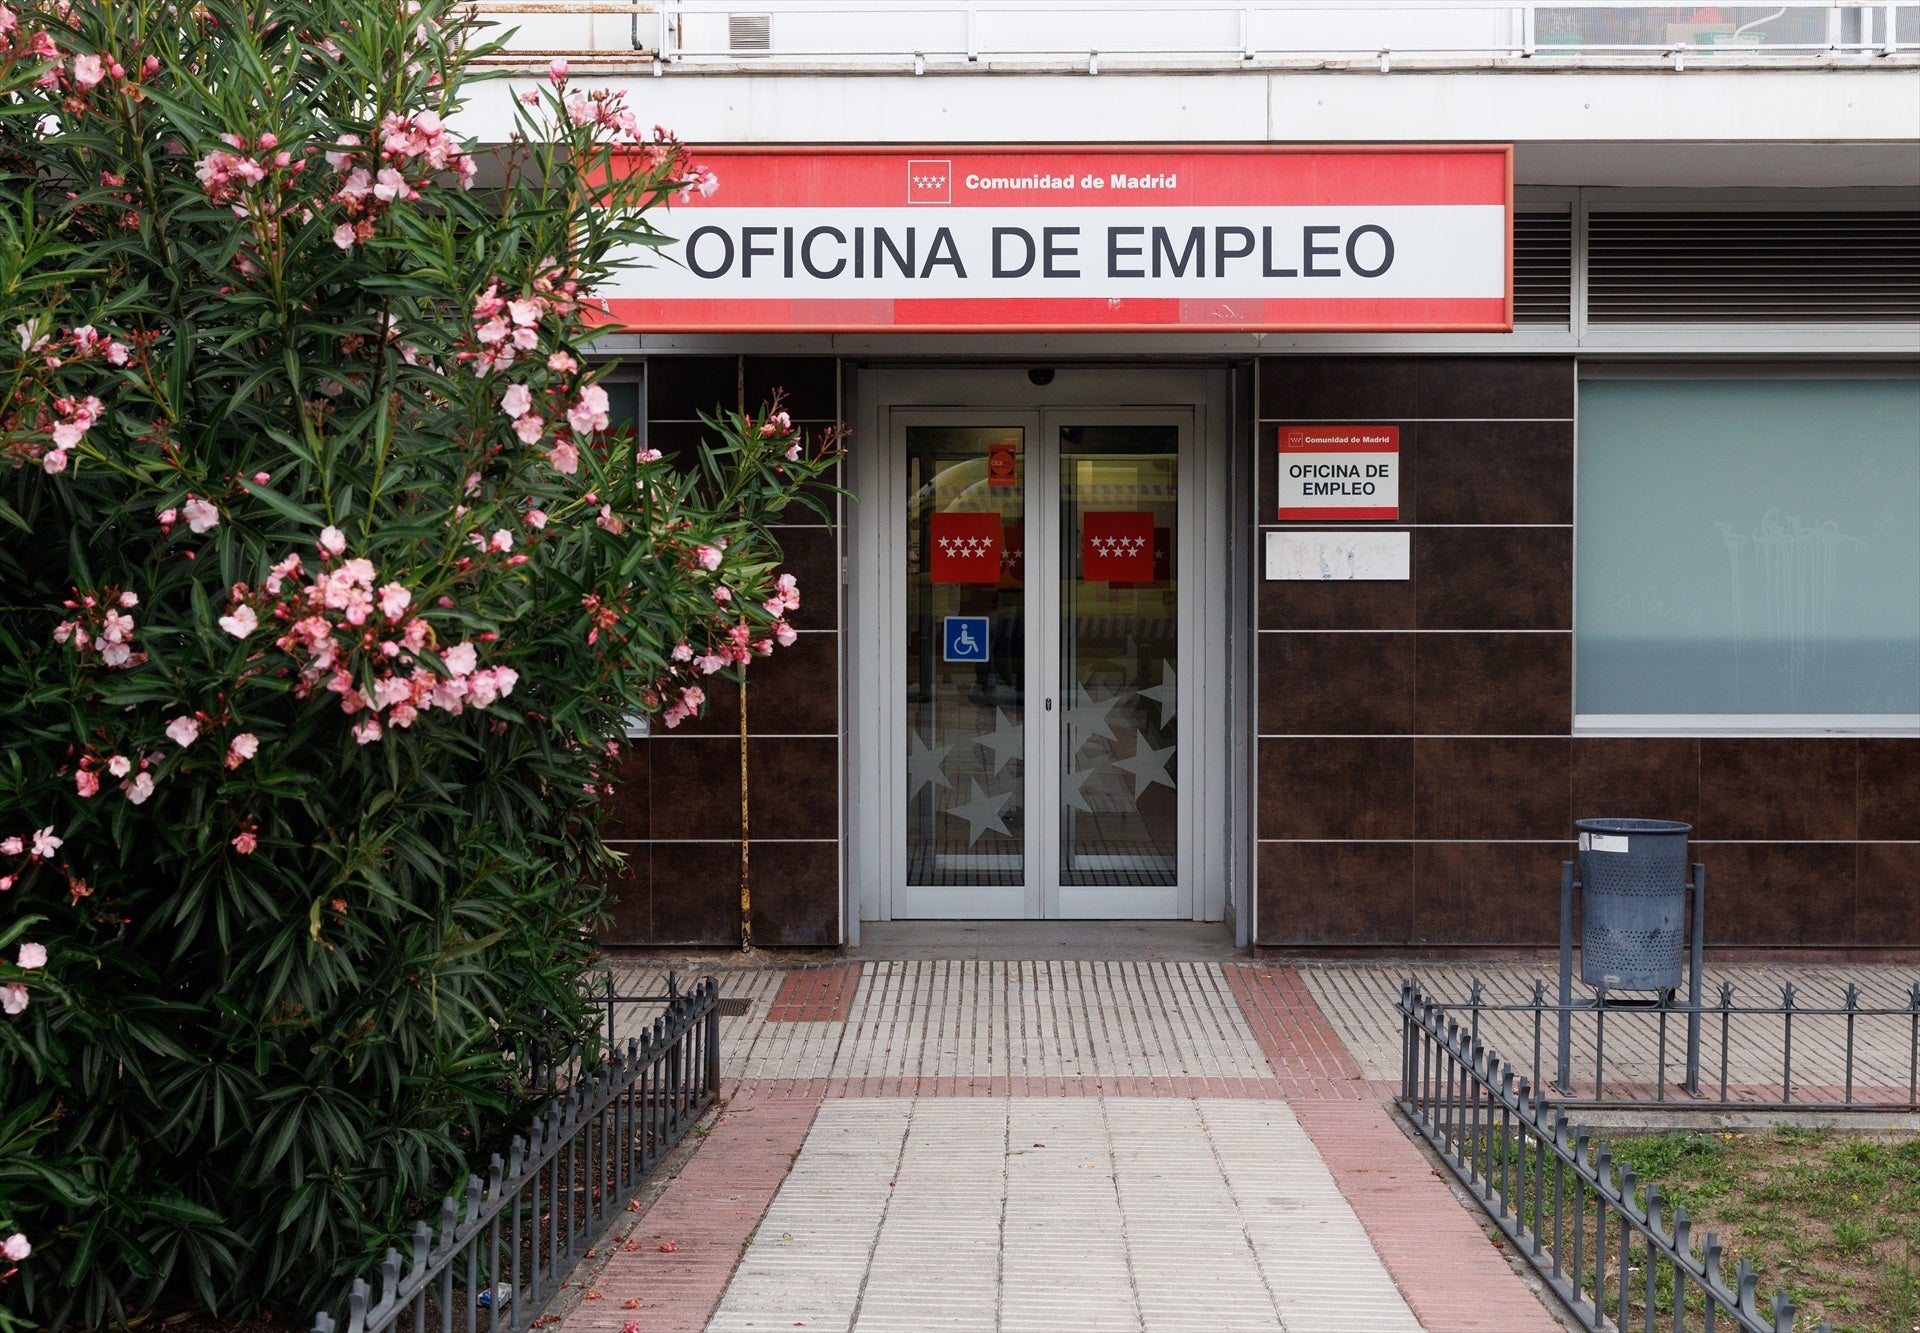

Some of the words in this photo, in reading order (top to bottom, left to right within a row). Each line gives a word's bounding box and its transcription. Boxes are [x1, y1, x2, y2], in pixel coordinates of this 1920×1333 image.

[965, 174, 1075, 189] Comunidad
[1080, 174, 1105, 189] de
[1110, 173, 1177, 189] Madrid
[684, 225, 968, 280] OFICINA
[992, 226, 1081, 279] DE
[1107, 224, 1395, 279] EMPLEO
[1305, 436, 1349, 444] Comunidad
[1350, 436, 1361, 444] de
[1362, 436, 1390, 444] Madrid
[1289, 464, 1360, 478] OFICINA
[1365, 464, 1389, 478] DE
[1303, 481, 1376, 496] EMPLEO
